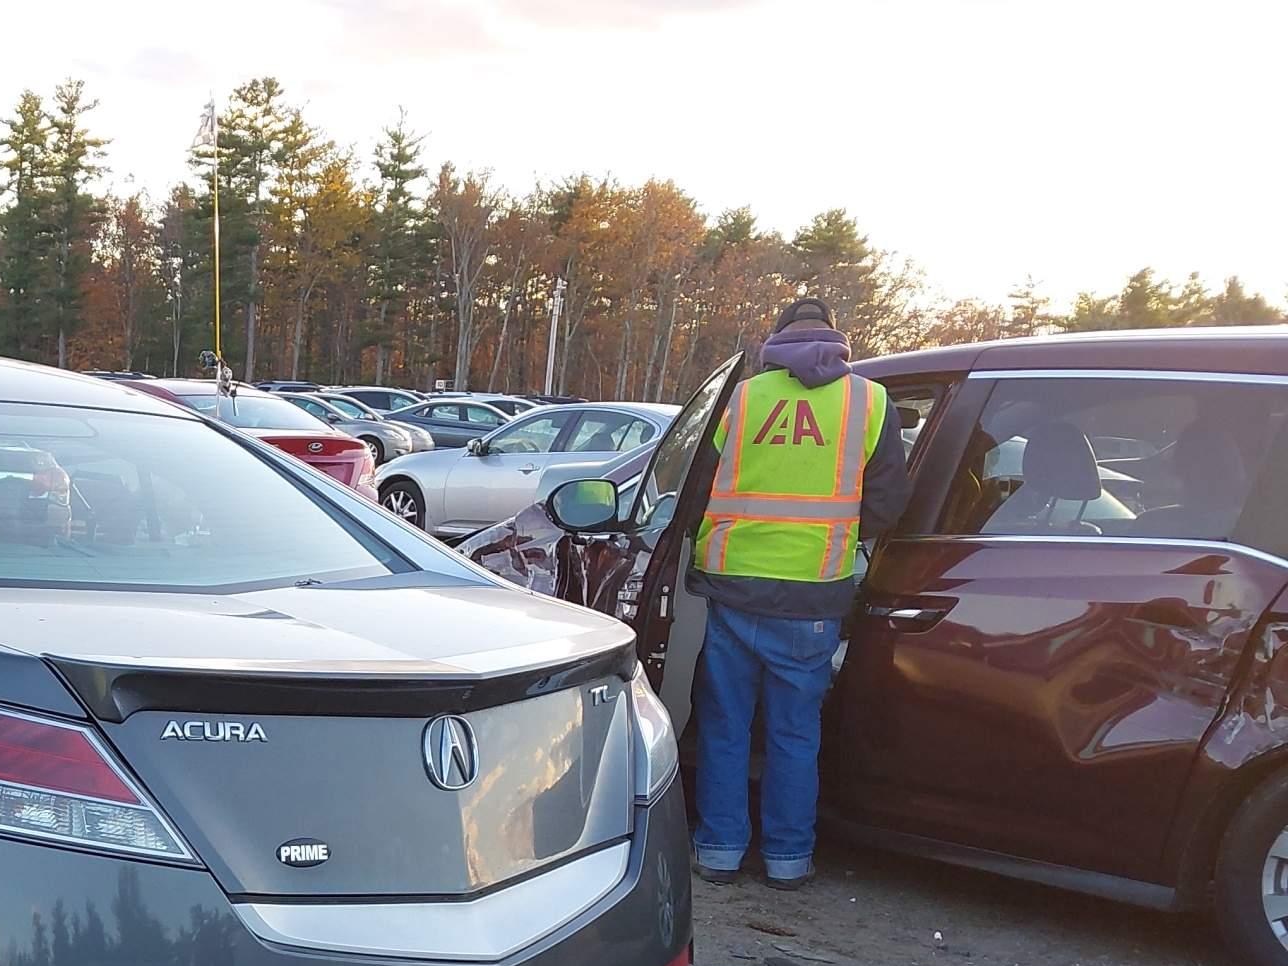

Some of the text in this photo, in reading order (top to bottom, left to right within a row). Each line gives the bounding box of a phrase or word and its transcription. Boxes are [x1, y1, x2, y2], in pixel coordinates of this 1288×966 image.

[589, 685, 617, 706] TL
[160, 719, 269, 742] ACURA
[280, 844, 329, 862] PRIME
